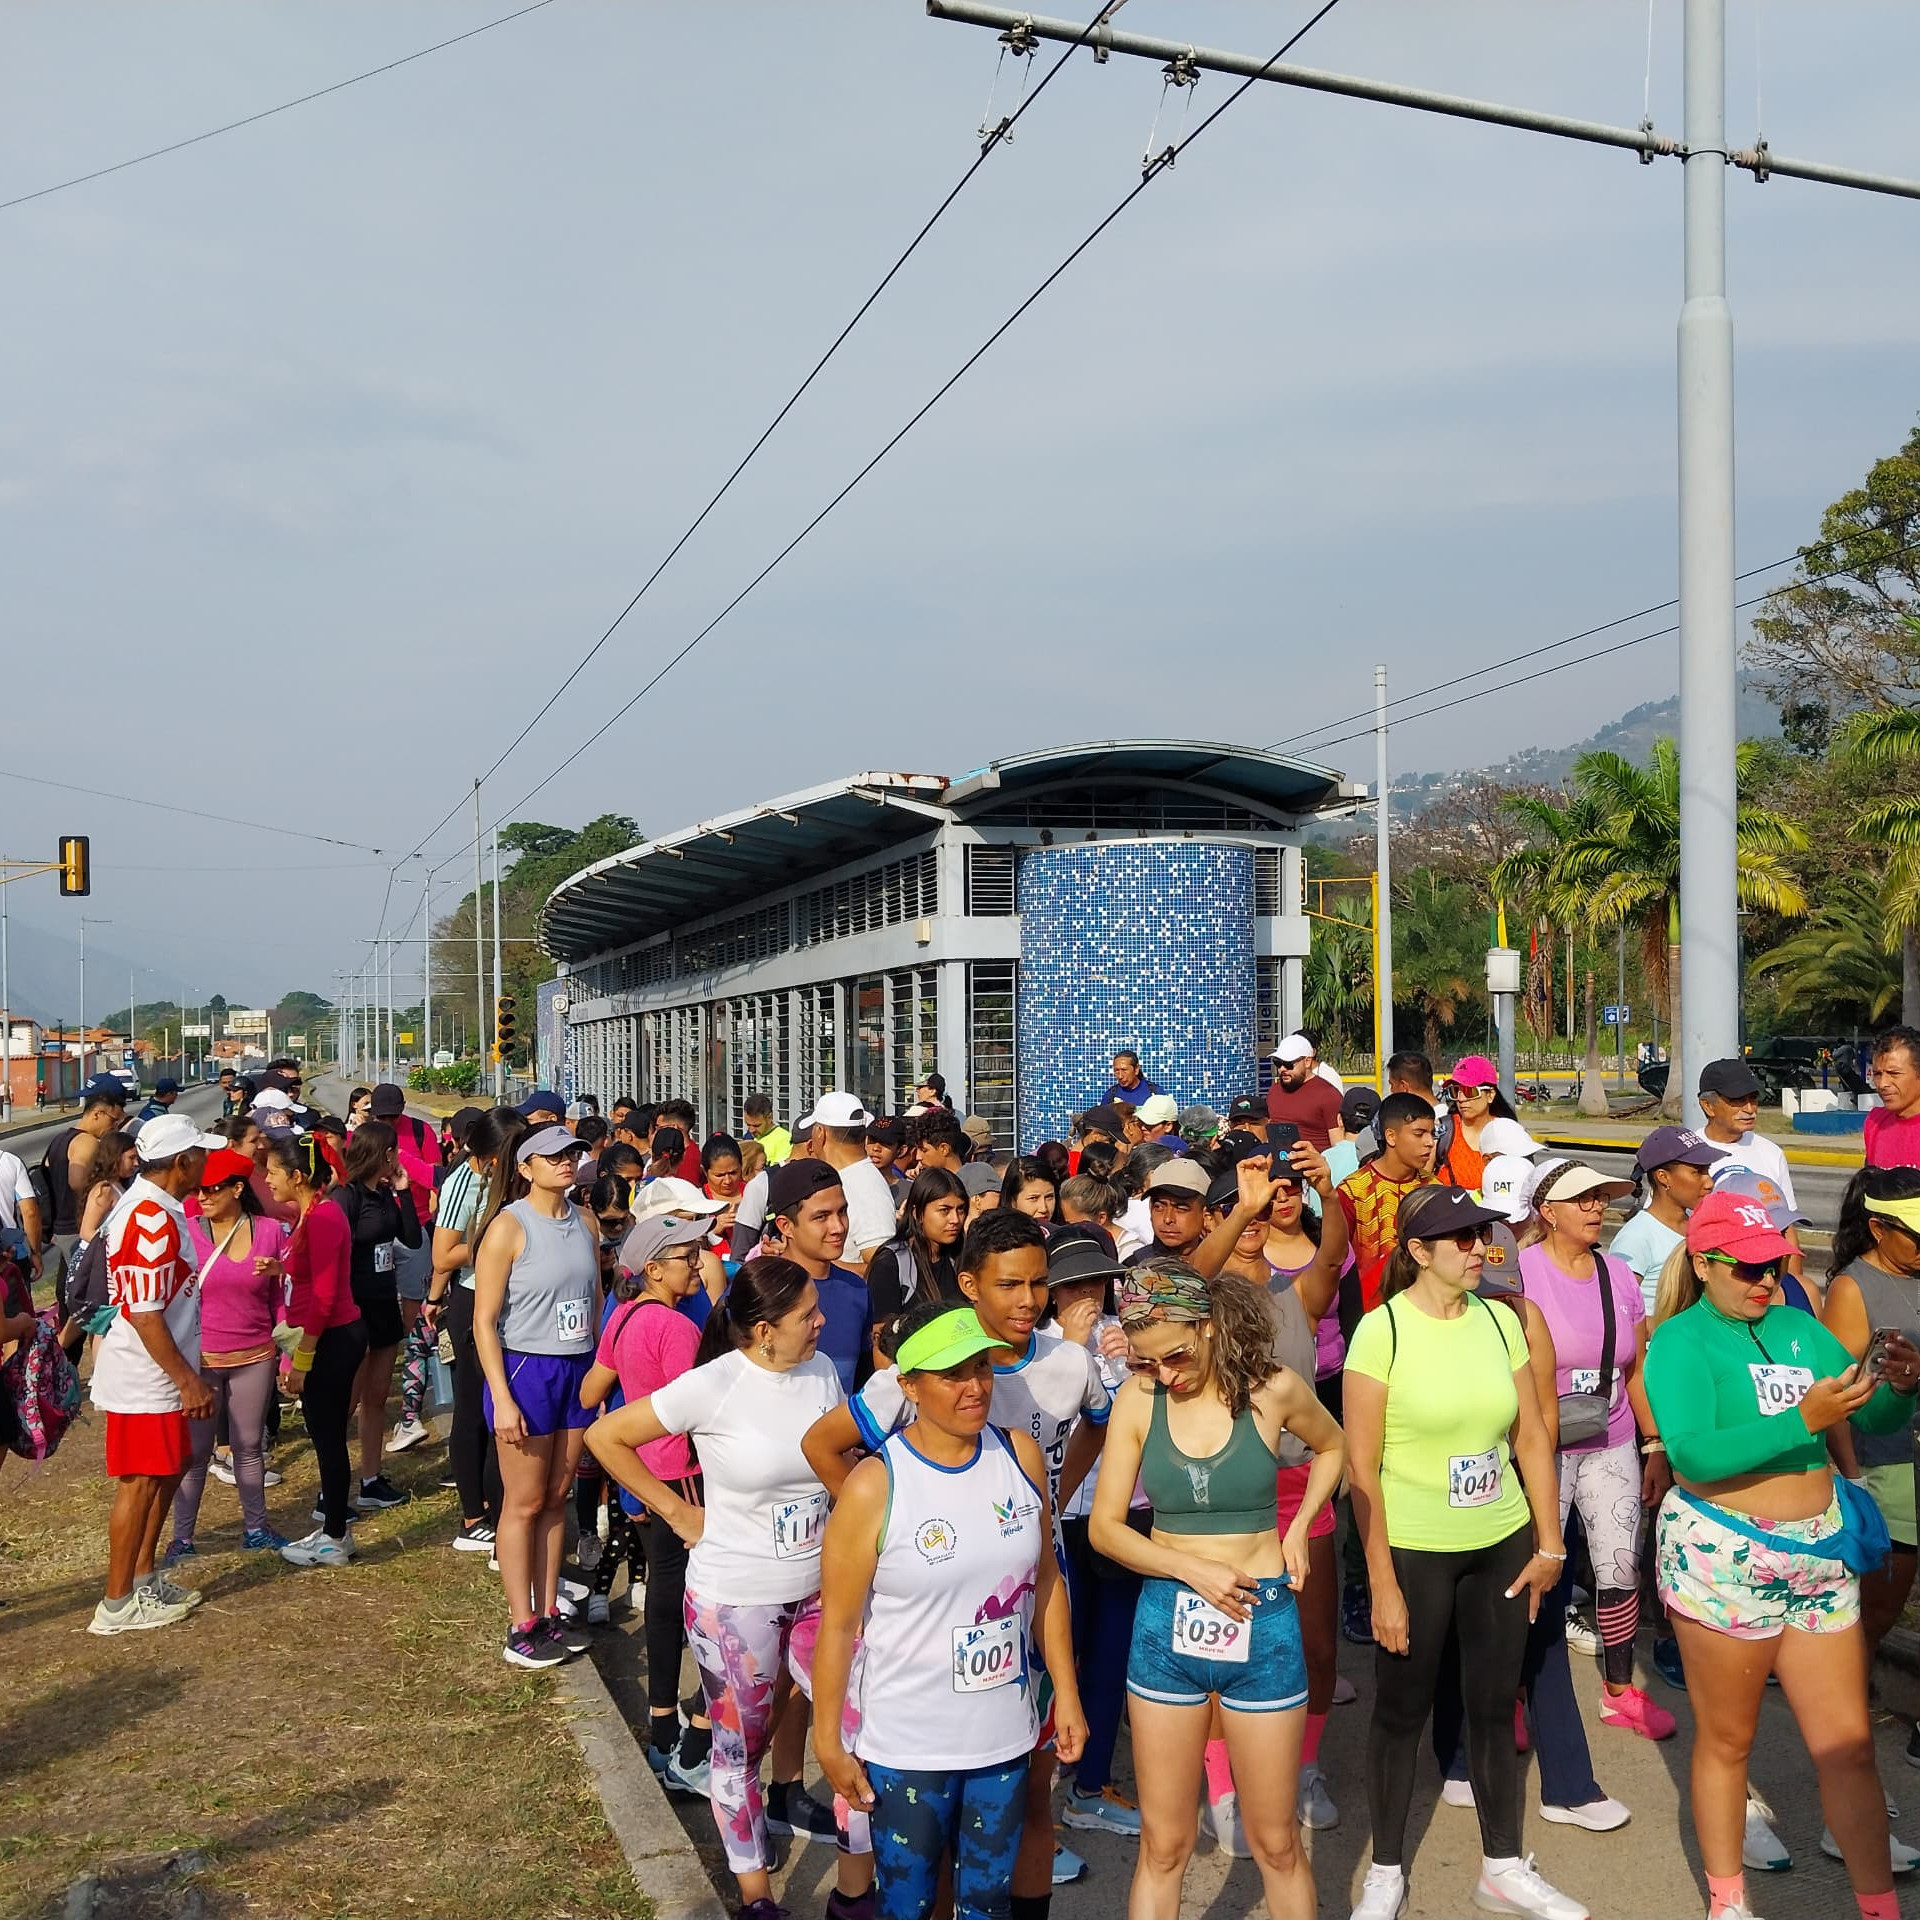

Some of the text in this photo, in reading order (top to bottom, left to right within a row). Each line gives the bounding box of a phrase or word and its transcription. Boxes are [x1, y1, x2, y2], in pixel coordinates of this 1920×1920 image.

[1493, 1182, 1511, 1193] CAT
[1464, 1469, 1497, 1495] 042
[1189, 1619, 1239, 1646] 039
[971, 1641, 1013, 1676] 002
